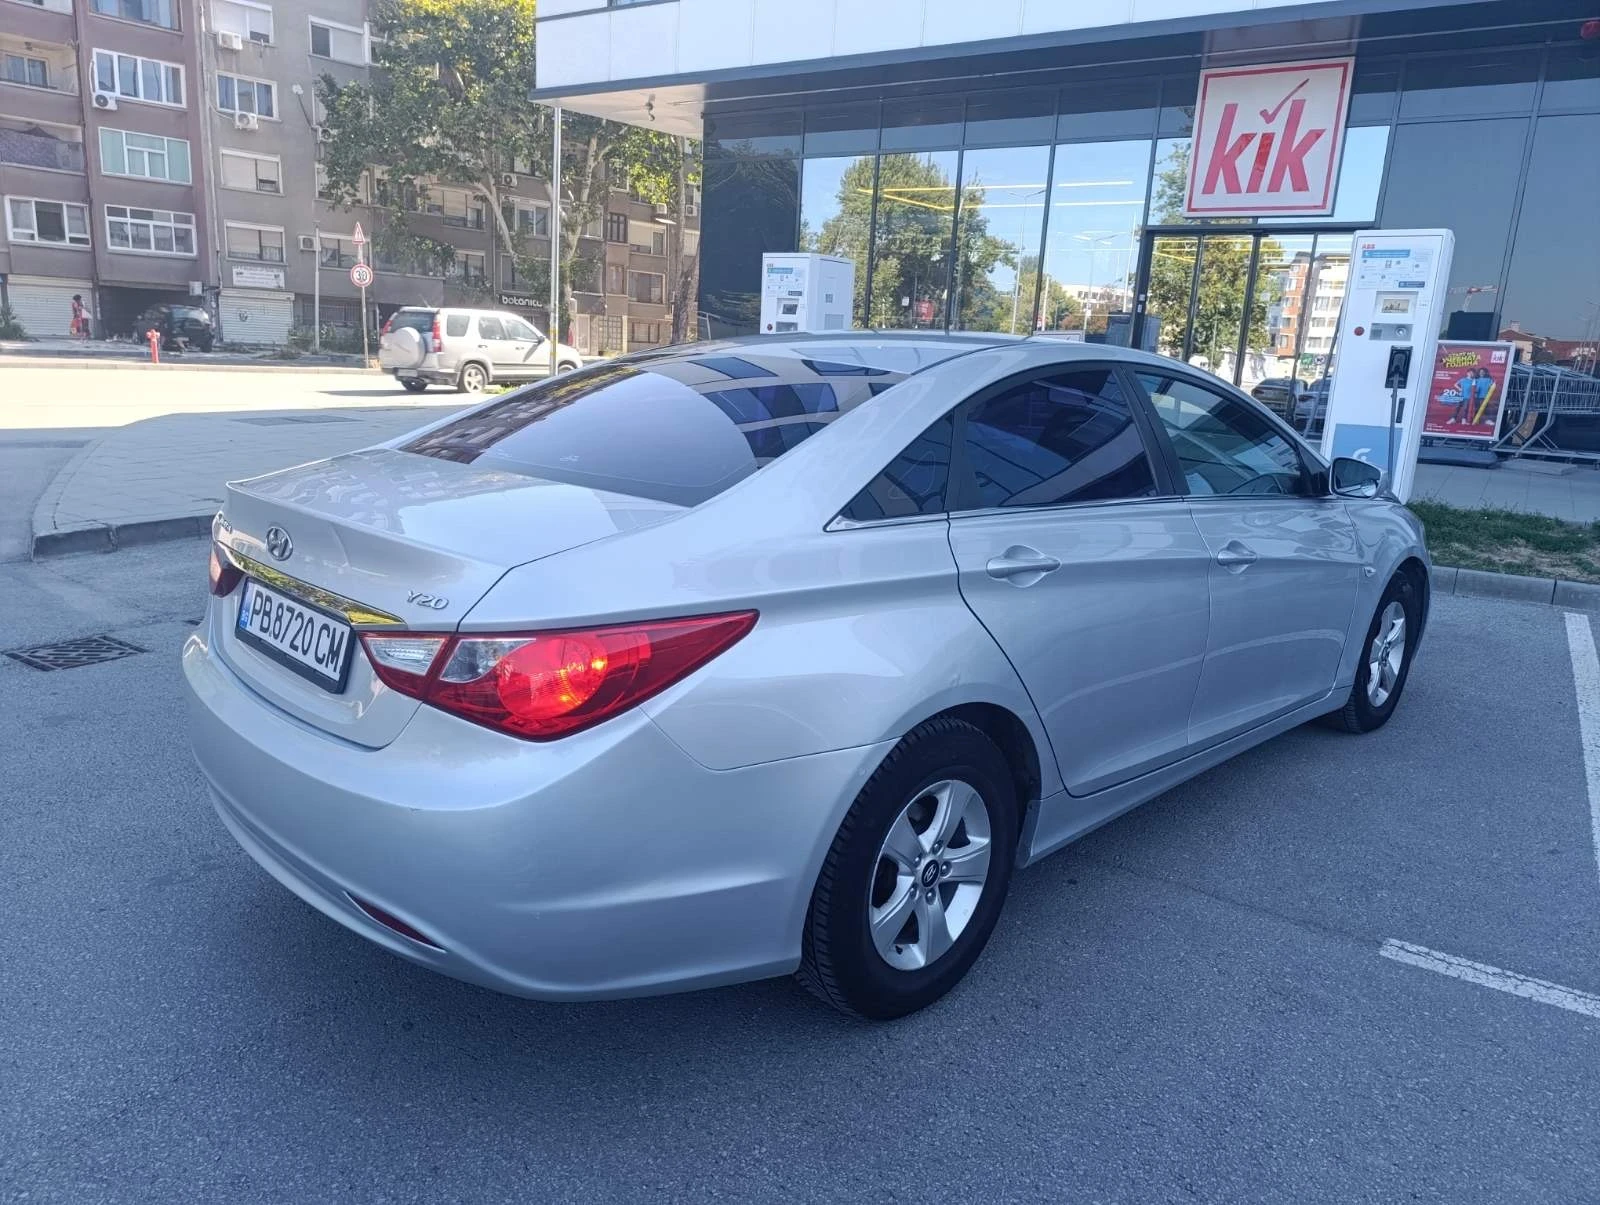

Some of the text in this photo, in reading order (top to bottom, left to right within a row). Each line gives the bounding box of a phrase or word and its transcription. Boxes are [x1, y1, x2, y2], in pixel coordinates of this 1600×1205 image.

[1202, 79, 1326, 195] kik
[355, 270, 368, 282] 30
[407, 590, 450, 610] Y20
